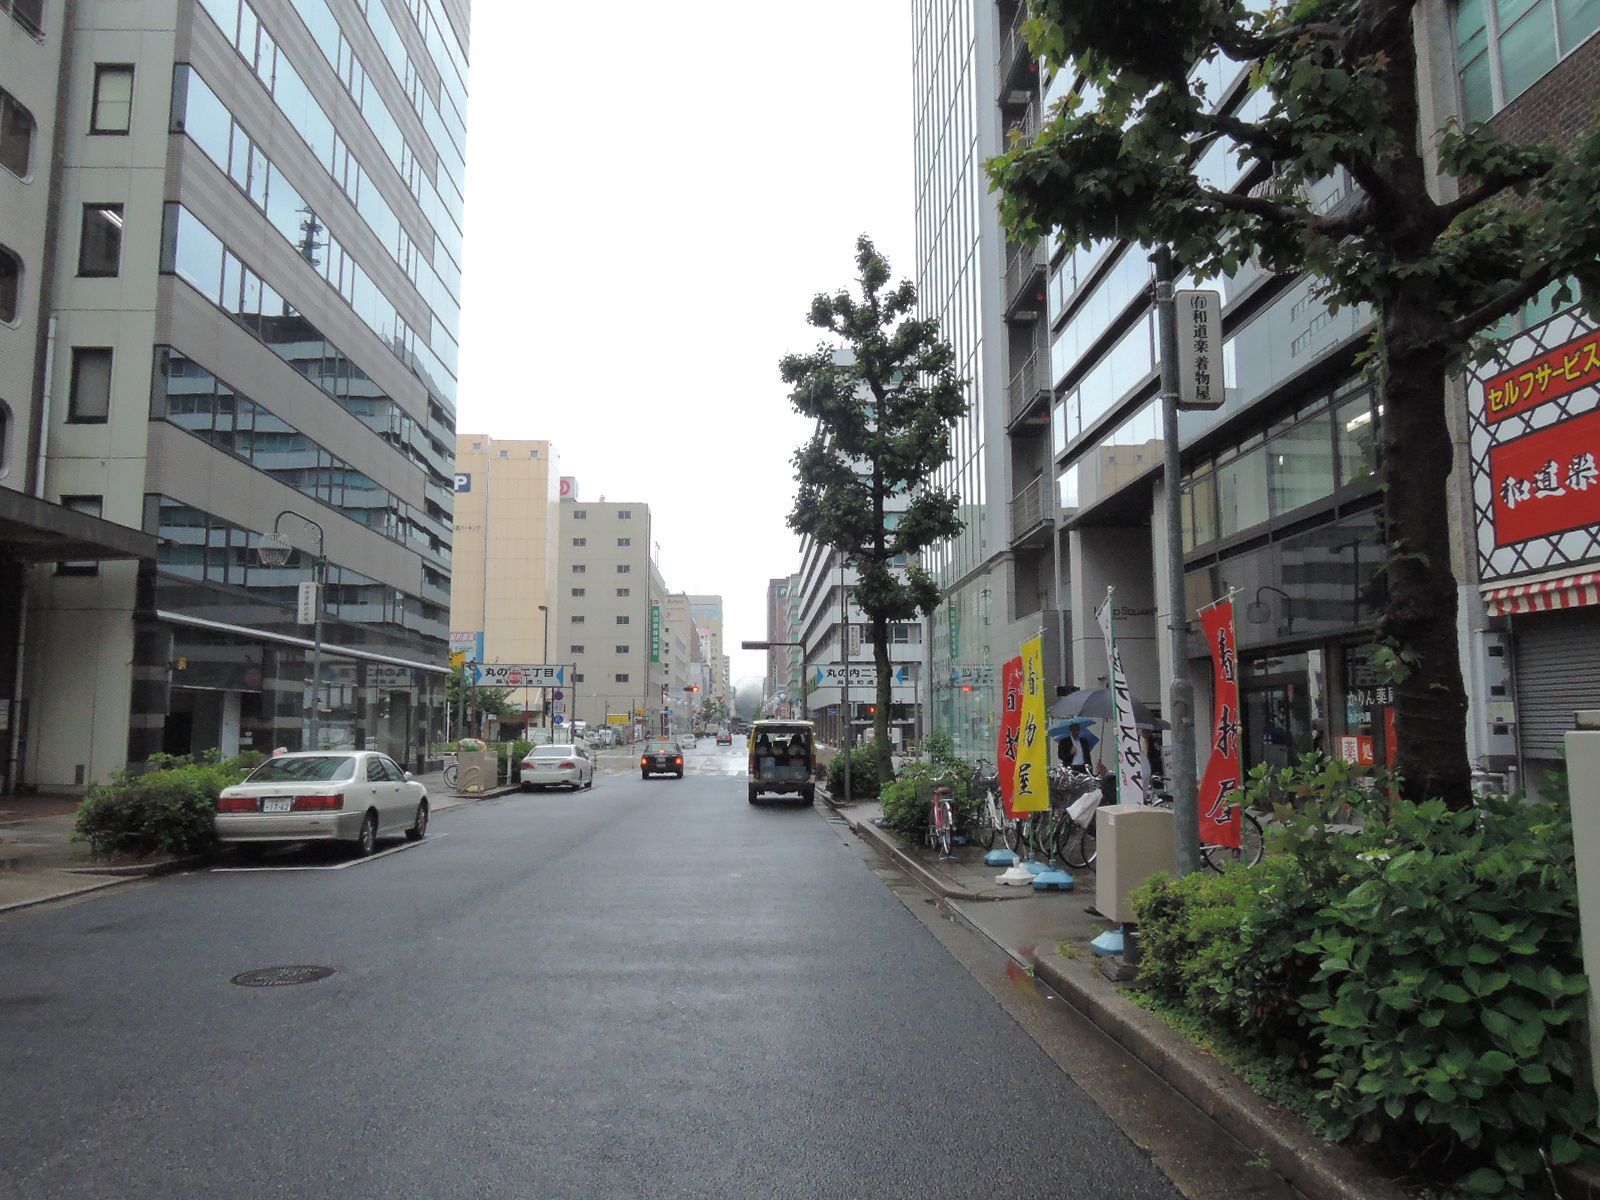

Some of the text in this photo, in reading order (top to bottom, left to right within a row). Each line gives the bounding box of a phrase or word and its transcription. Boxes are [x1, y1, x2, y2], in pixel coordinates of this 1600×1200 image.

[1488, 343, 1600, 412] セルフサービス
[485, 668, 554, 678] 丸の二丁目
[826, 668, 892, 678] 丸の内二
